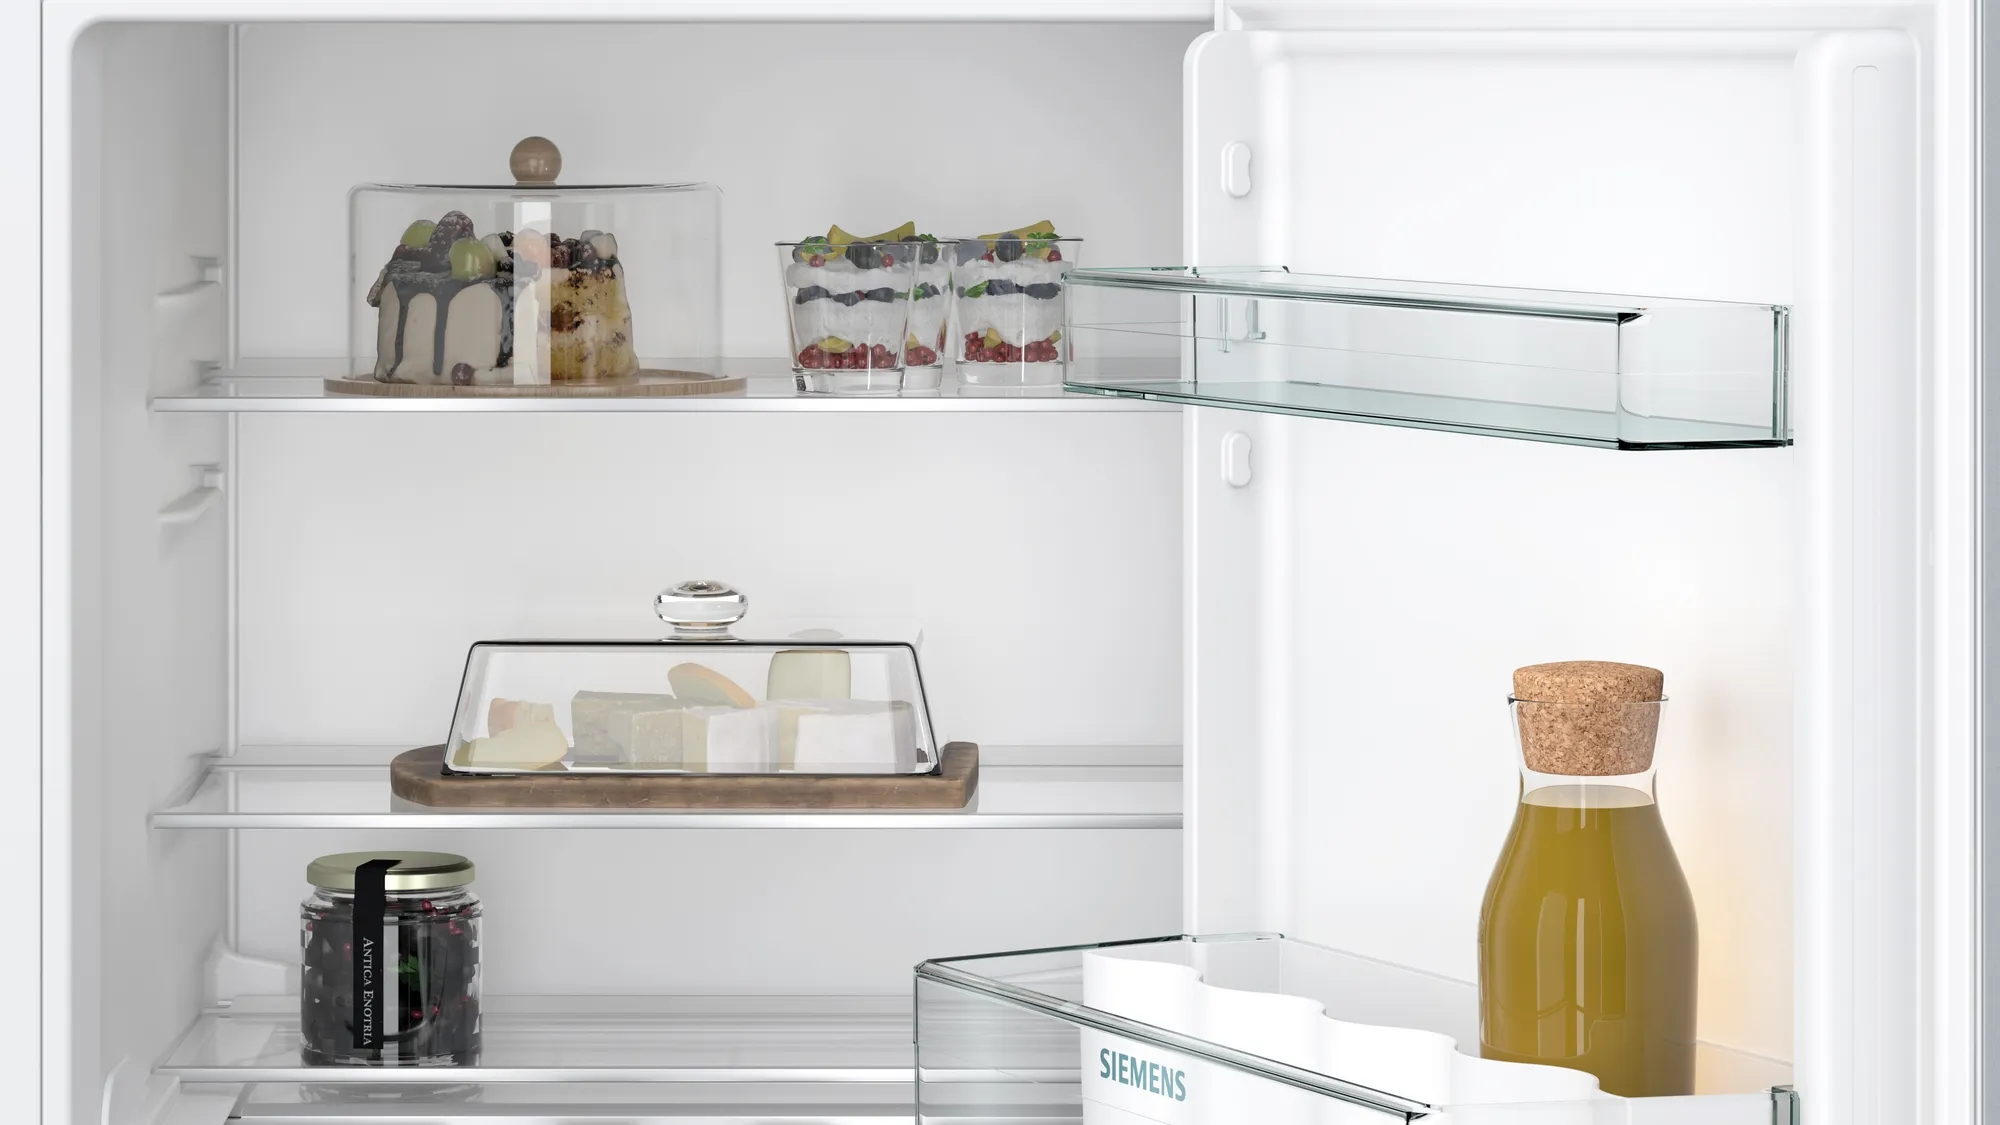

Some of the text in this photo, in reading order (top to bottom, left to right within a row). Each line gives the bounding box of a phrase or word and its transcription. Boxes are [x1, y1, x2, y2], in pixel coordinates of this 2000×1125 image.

[363, 937, 374, 1045] ANTICA ENOTRIA
[1100, 1048, 1186, 1102] SIEMENS
